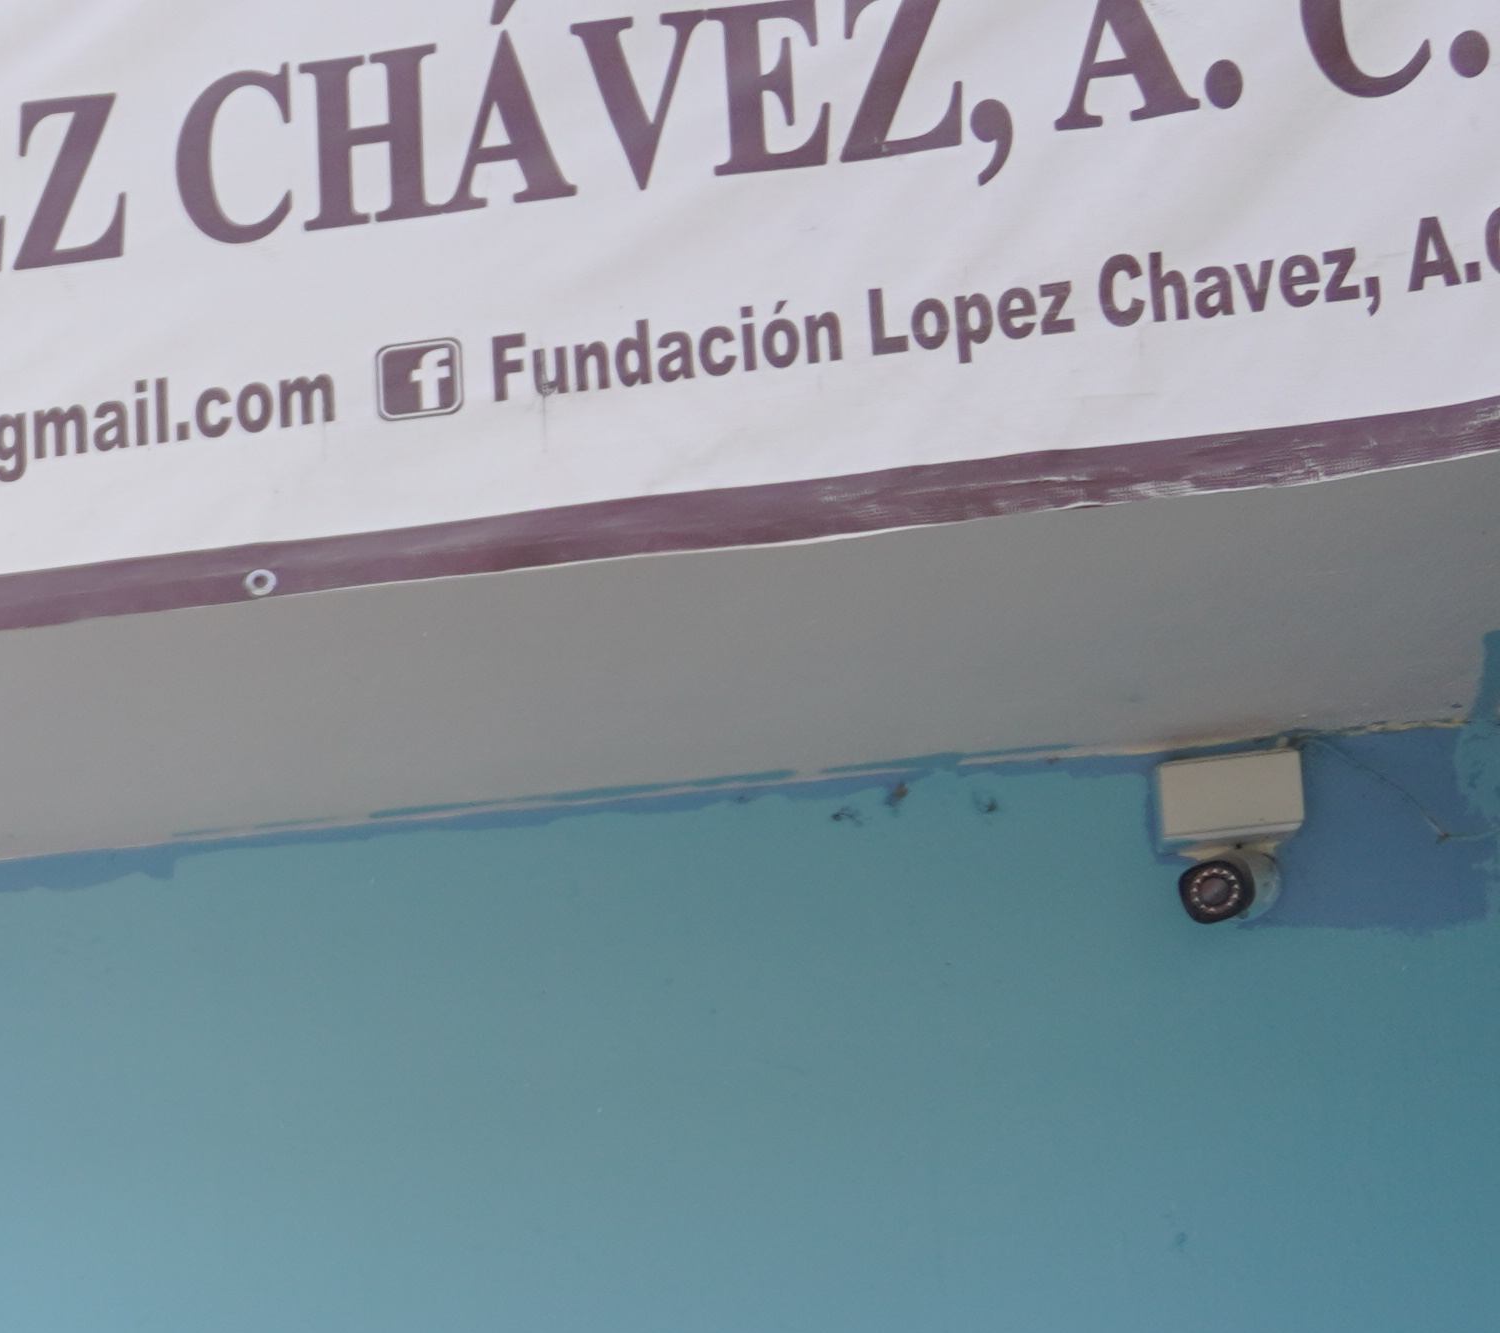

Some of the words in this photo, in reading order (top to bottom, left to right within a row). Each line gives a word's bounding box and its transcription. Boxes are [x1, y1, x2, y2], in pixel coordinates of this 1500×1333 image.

[175, 0, 1013, 245] CHÁVEZ,
[491, 311, 843, 402] Fundación
[868, 280, 1076, 364] Lopez
[1098, 247, 1381, 328] Chavez,
